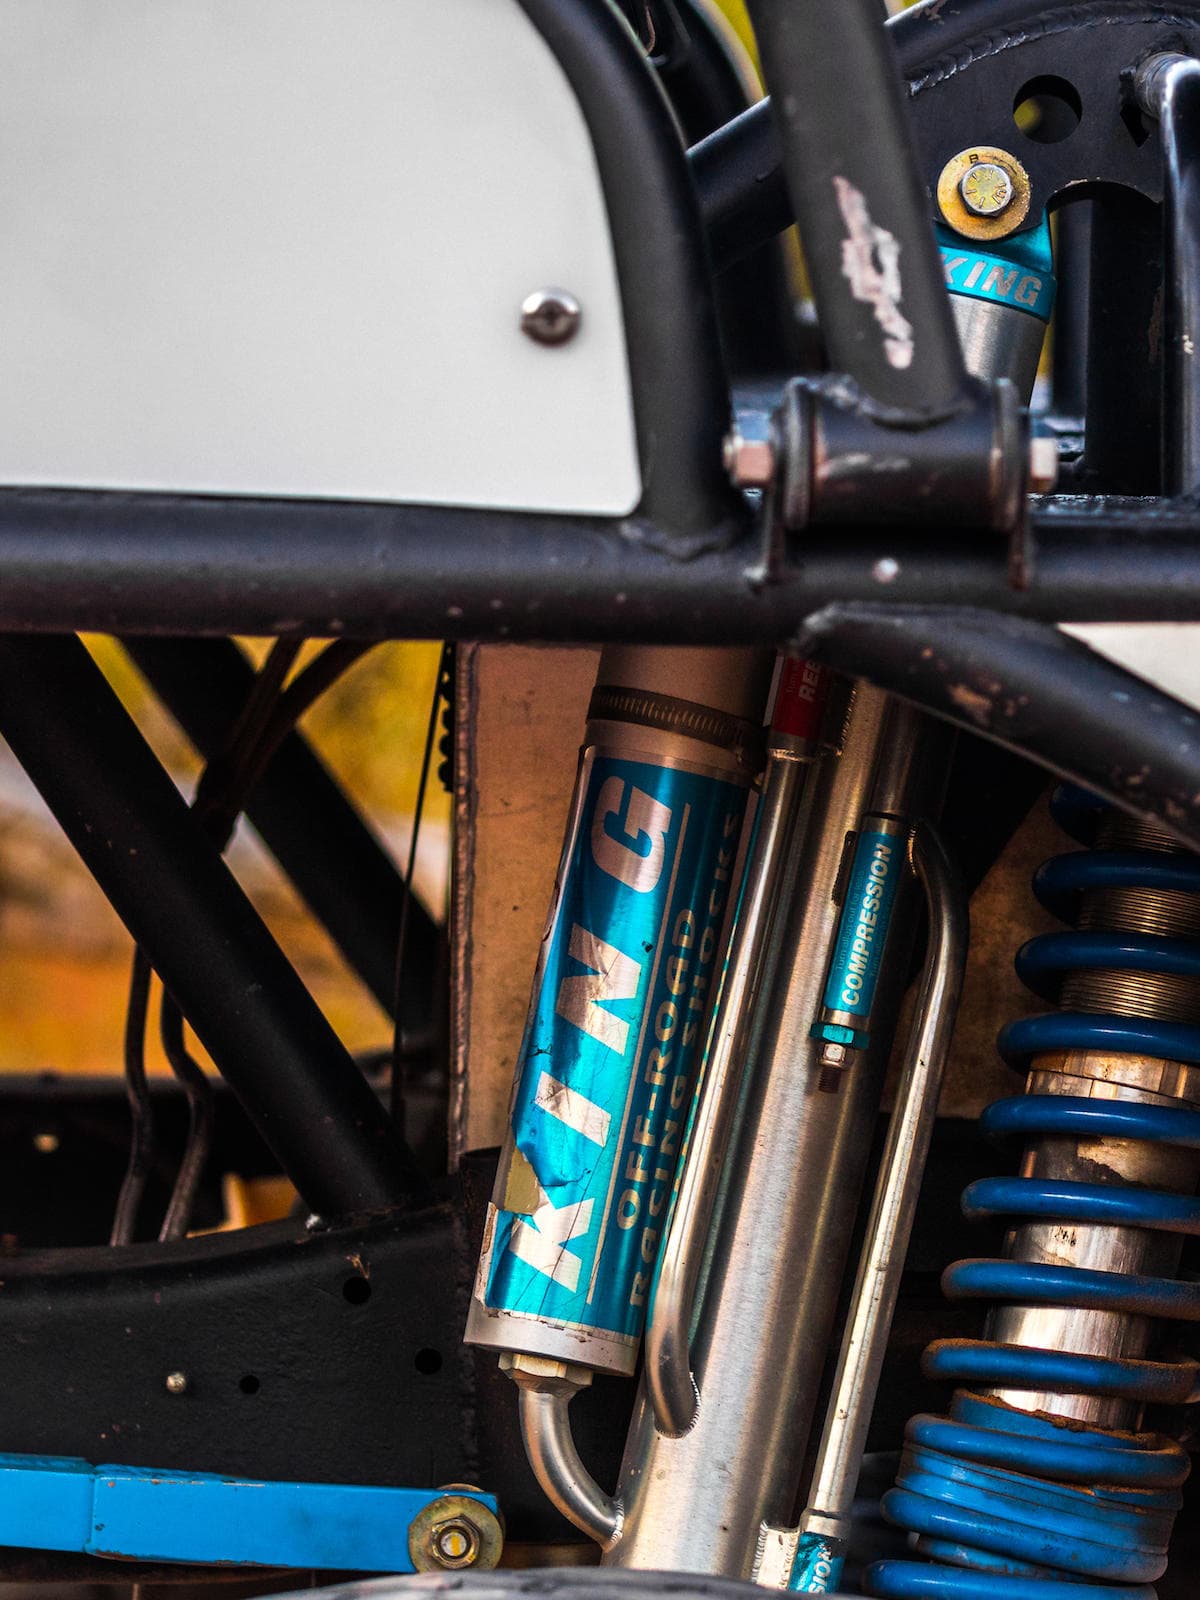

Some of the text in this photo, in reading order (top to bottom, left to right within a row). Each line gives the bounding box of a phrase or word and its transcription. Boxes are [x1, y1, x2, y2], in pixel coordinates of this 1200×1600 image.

[946, 253, 1052, 306] KING
[508, 775, 673, 1293] KING
[682, 812, 738, 1047] SHOCKS
[841, 842, 892, 1007] COMPRESSION
[616, 908, 696, 1230] OFF-ROAD
